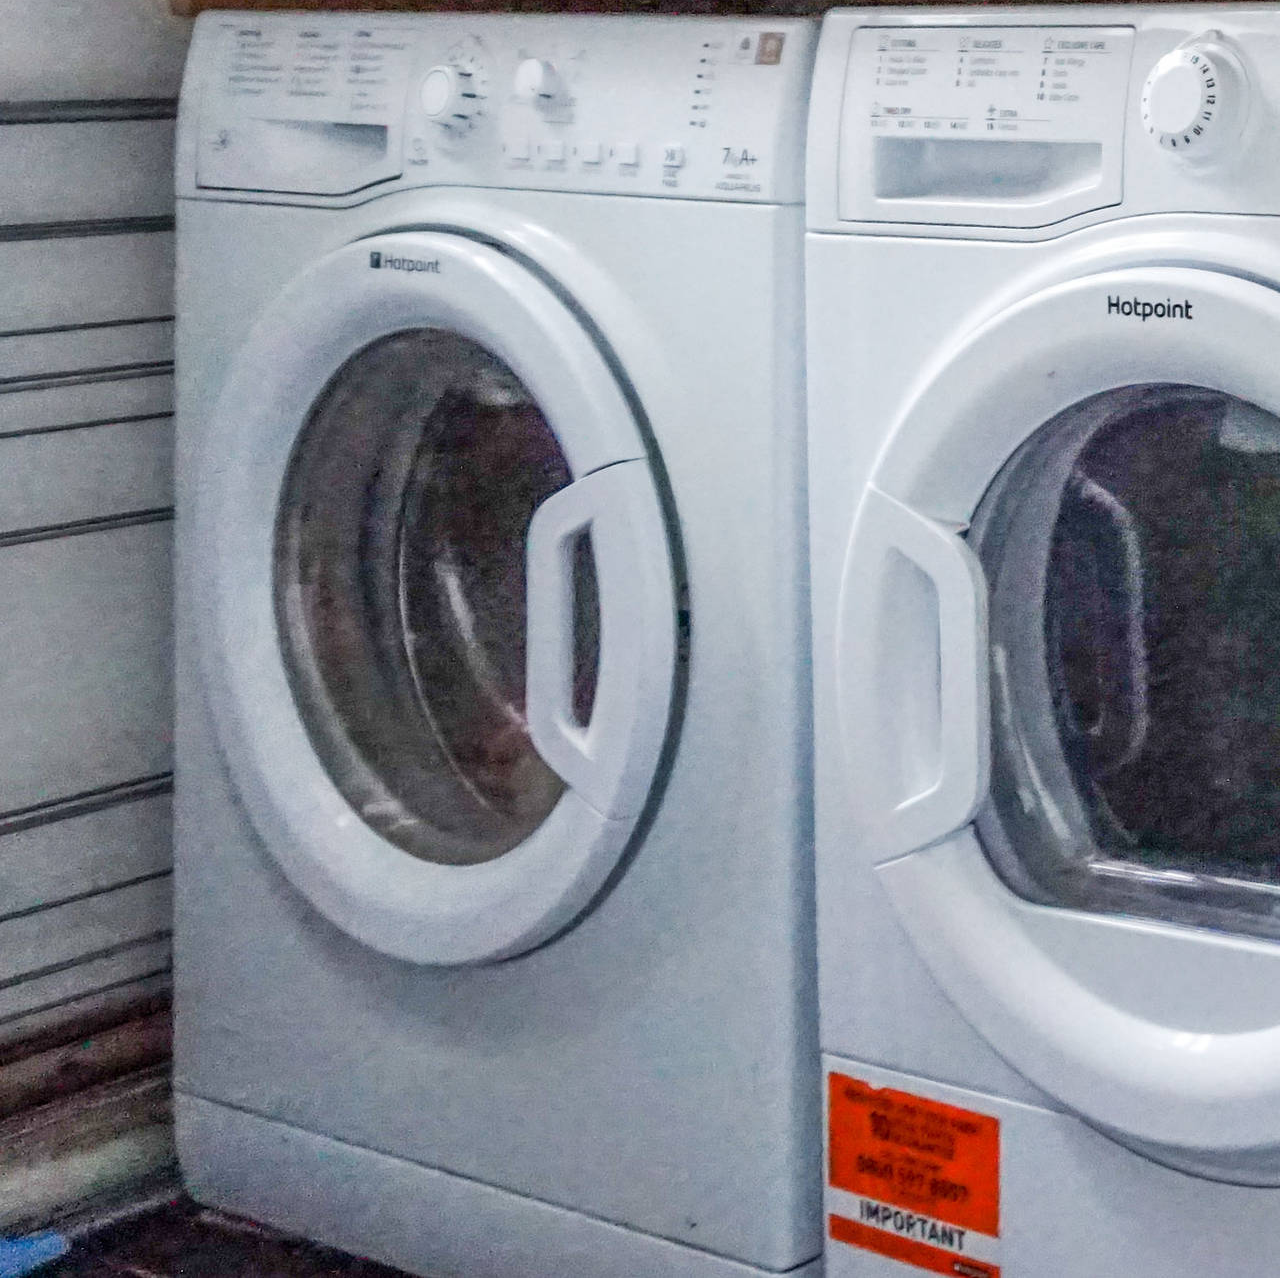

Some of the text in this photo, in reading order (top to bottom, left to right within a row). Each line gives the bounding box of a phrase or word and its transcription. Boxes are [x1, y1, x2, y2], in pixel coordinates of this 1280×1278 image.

[1206, 77, 1216, 89] 13
[1206, 94, 1216, 105] 12
[1202, 111, 1212, 121] 11
[384, 253, 442, 274] Hotpoint
[1107, 295, 1193, 322] Hotpoint
[860, 1200, 966, 1250] IMPORTANT
